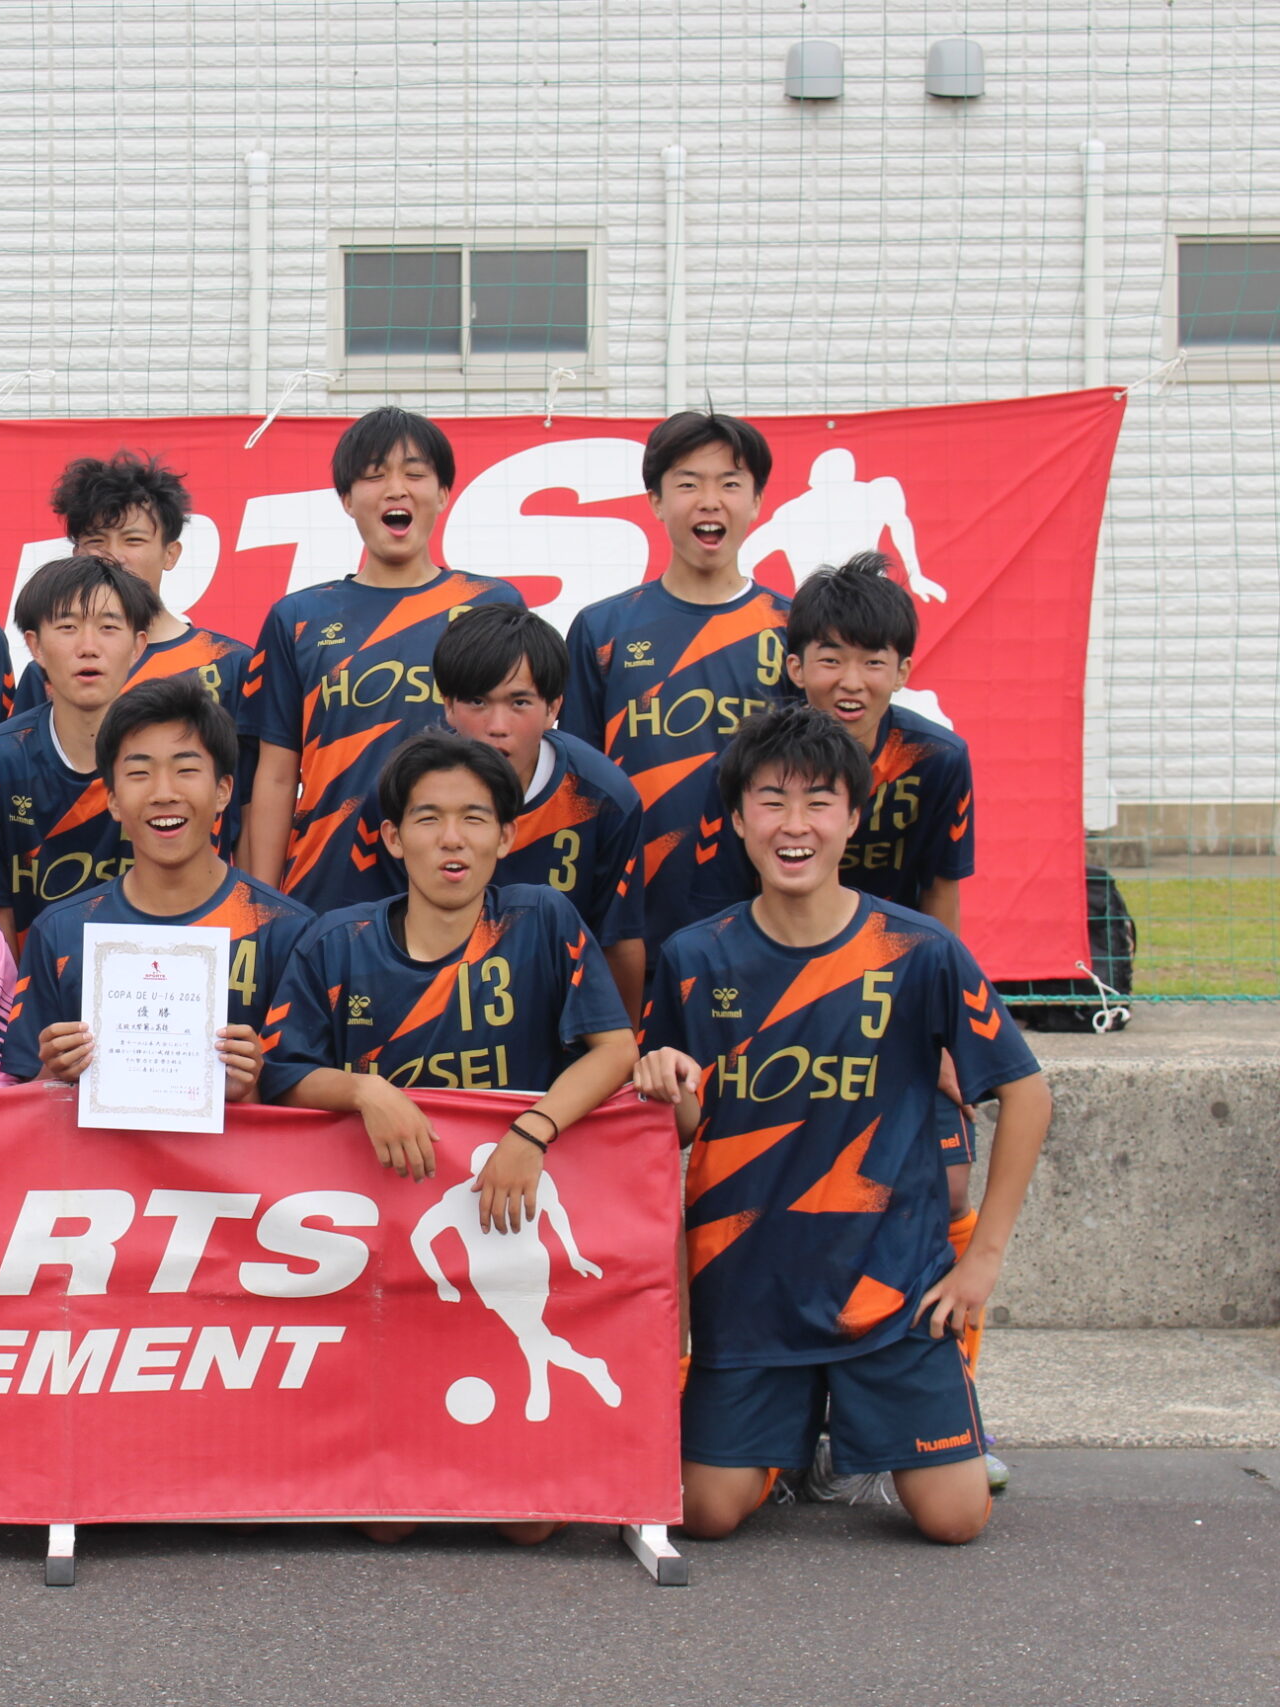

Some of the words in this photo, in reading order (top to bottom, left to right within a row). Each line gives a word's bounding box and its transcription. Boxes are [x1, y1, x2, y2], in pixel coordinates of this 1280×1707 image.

[624, 658, 655, 669] hummel
[757, 629, 784, 686] 9
[321, 660, 445, 711] HOS
[870, 776, 920, 831] 15
[12, 852, 136, 901] HOS
[548, 829, 580, 892] 3
[838, 837, 905, 870] SEI
[108, 990, 132, 1000] COPA
[136, 991, 149, 1000] DE
[151, 992, 175, 1001] U-16
[179, 993, 201, 1002] 2026
[228, 939, 257, 1006] 4
[457, 956, 515, 1032] 13
[137, 1005, 171, 1018] 優勝
[346, 1016, 373, 1026] ummel
[712, 1009, 742, 1018] hummel
[860, 969, 894, 1039] 5
[718, 1045, 879, 1102] HOSEI
[916, 1429, 972, 1453] hummel
